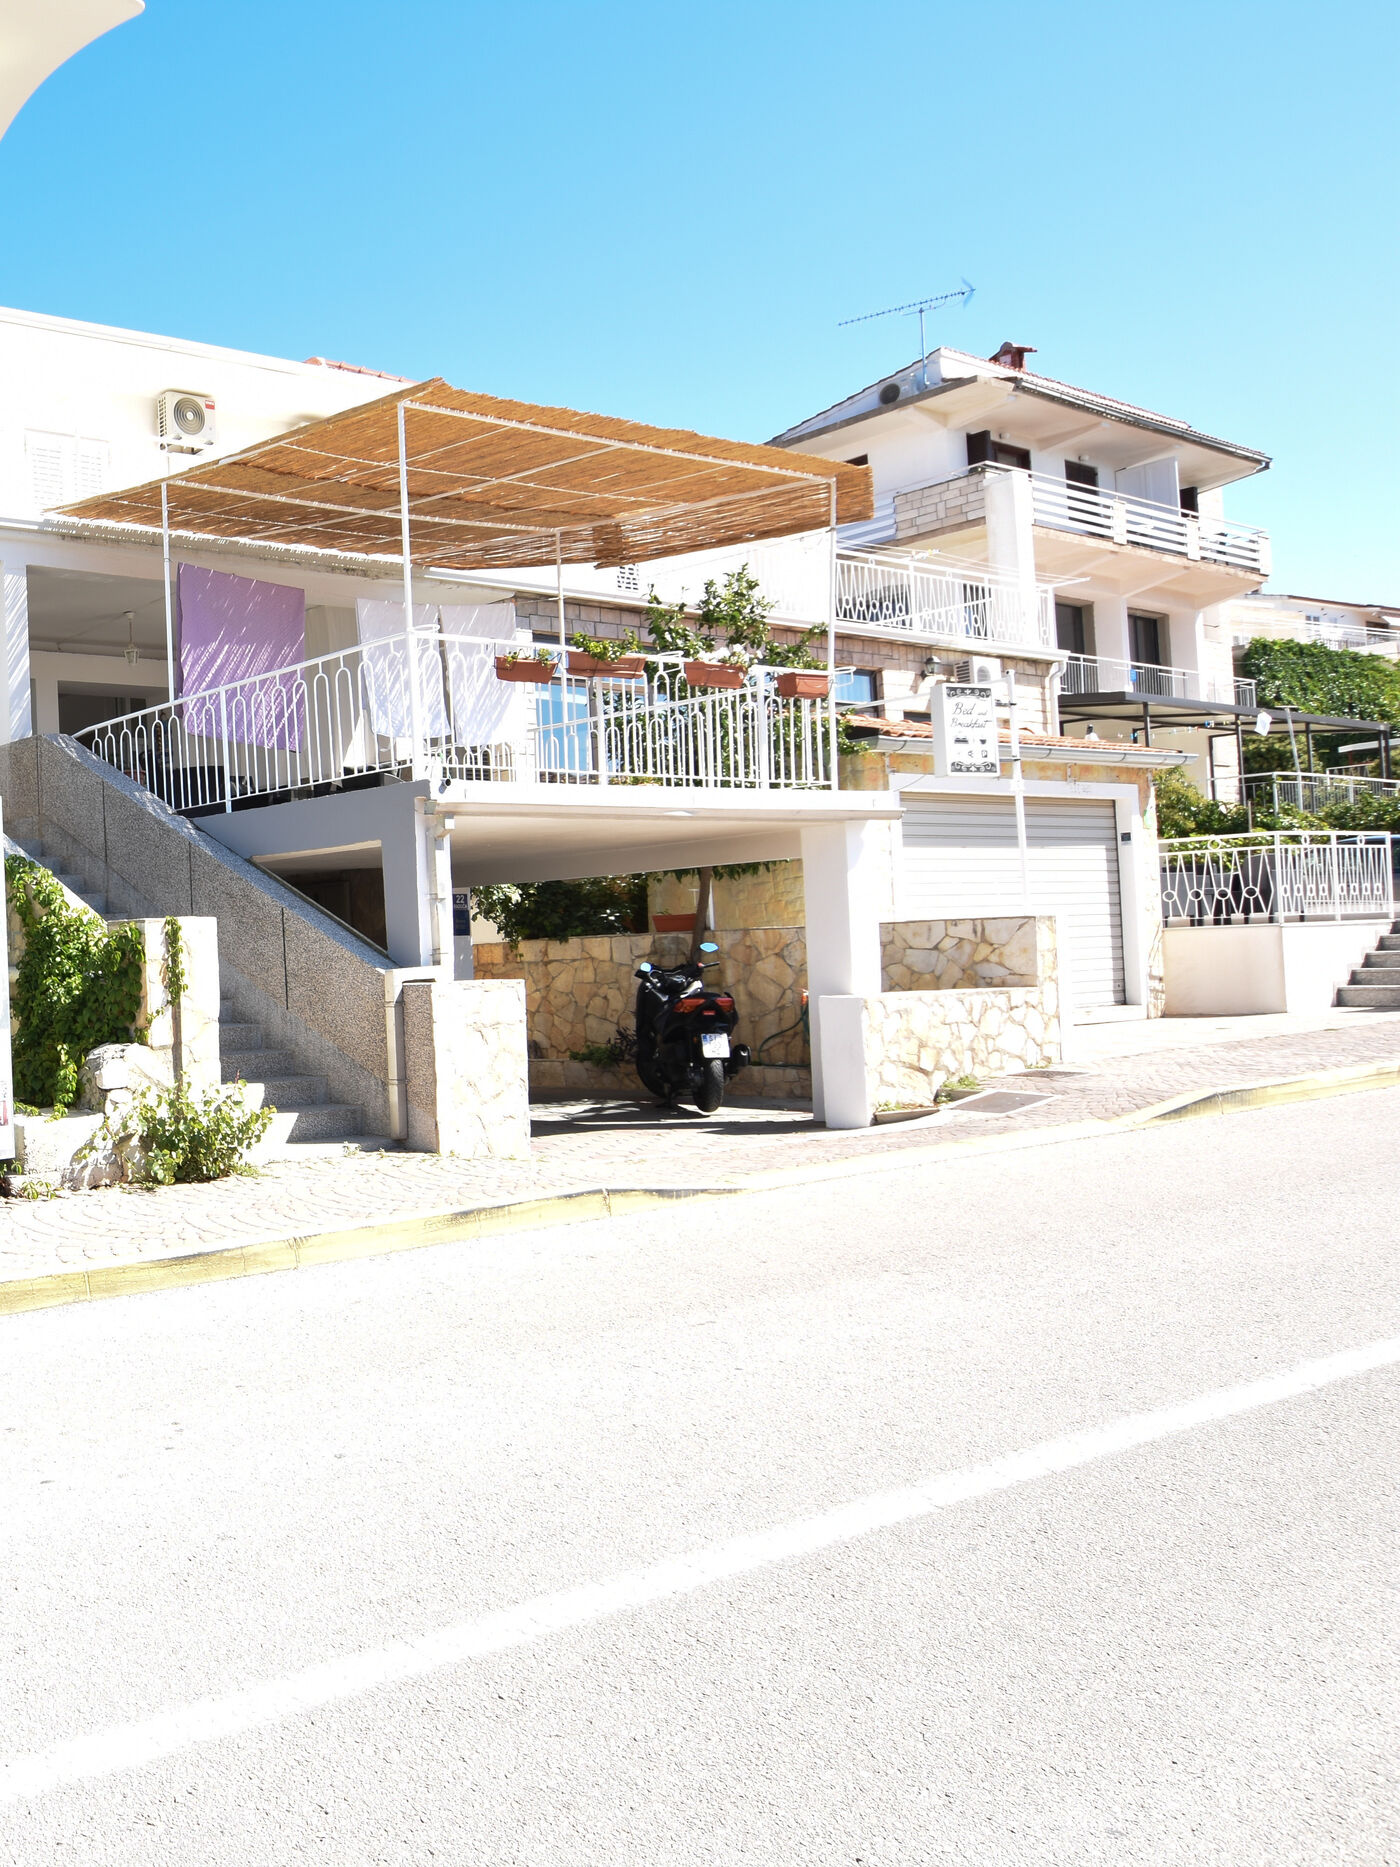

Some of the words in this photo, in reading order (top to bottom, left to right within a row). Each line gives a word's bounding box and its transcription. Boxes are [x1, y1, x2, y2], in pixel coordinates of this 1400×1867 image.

[952, 702, 976, 716] Bed
[950, 717, 992, 728] Breakfast
[456, 894, 465, 904] 22
